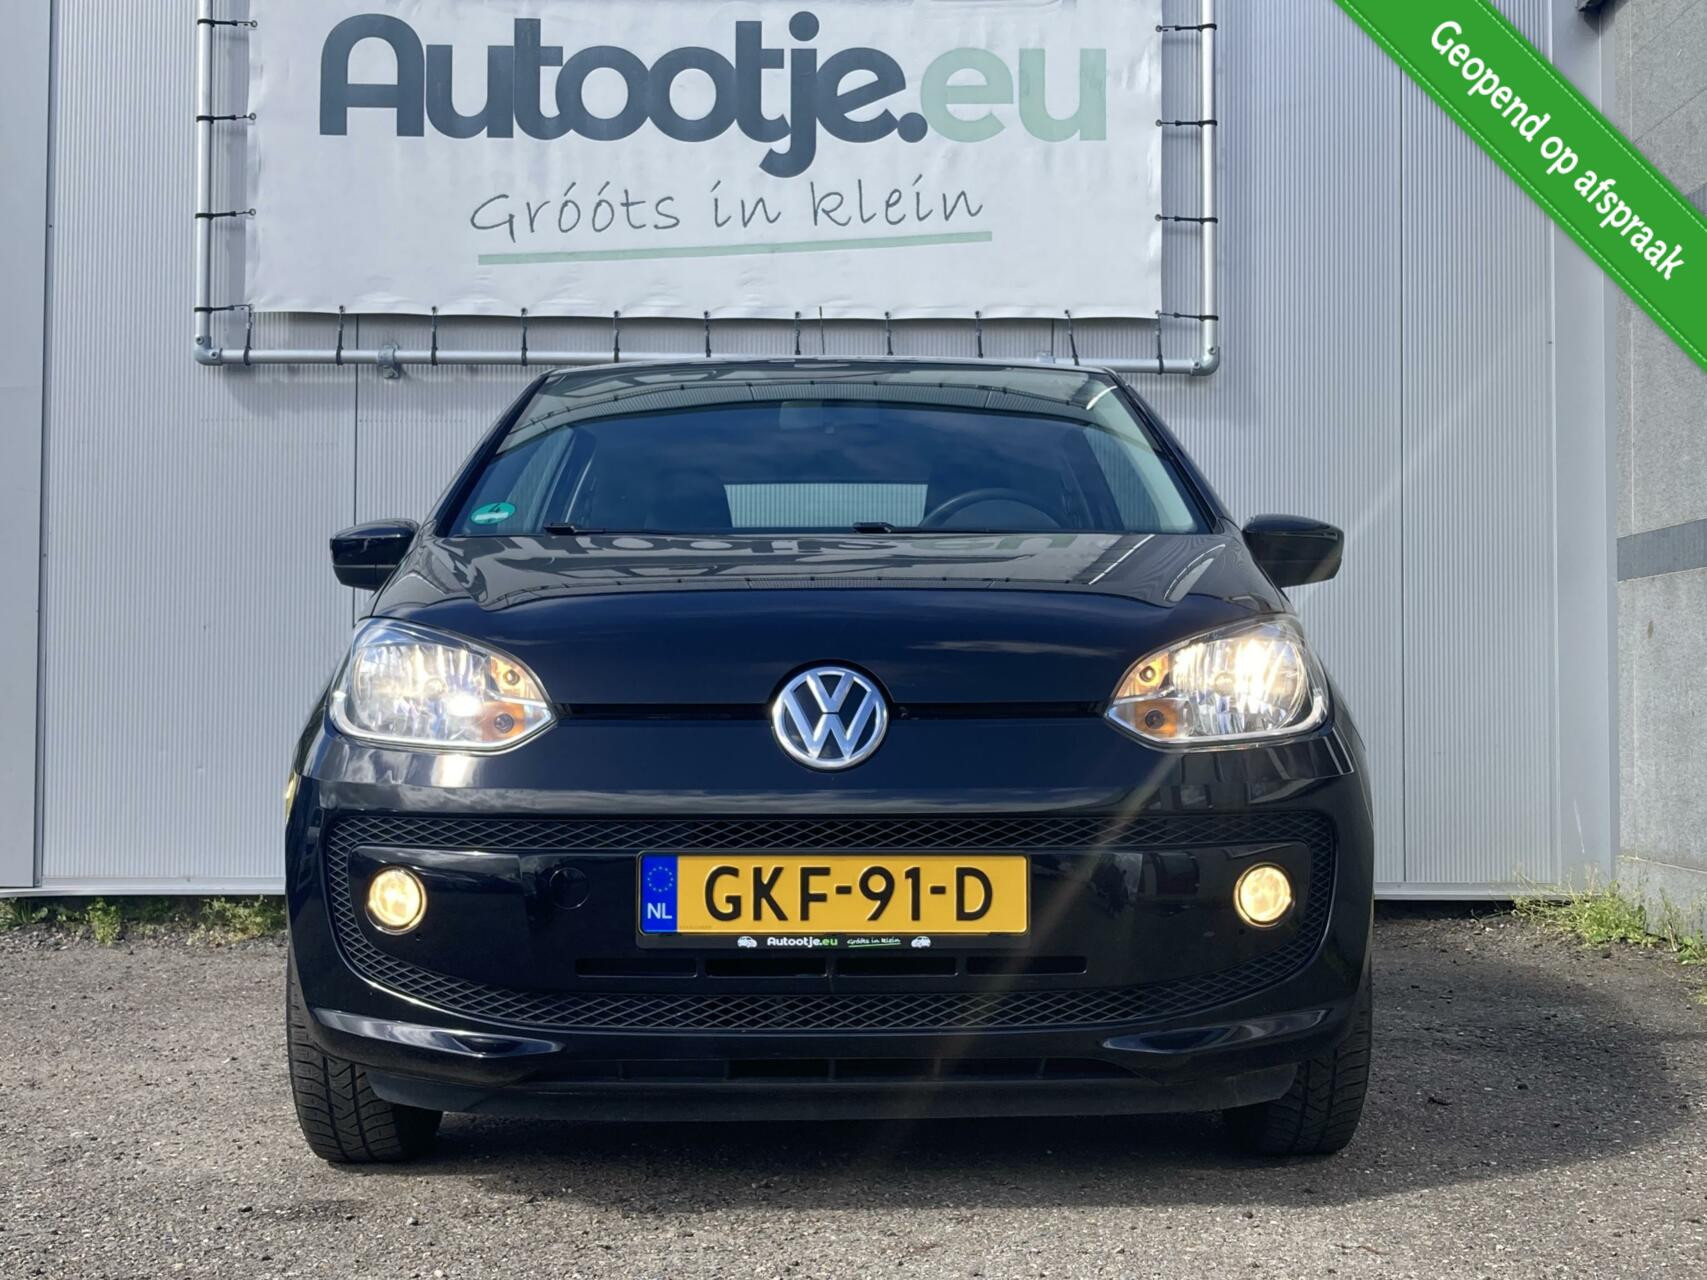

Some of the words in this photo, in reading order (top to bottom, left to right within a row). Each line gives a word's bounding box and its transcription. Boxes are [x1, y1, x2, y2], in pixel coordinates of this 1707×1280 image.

[319, 11, 1107, 178] Autootje.eu
[470, 182, 681, 241] Gróóts
[711, 181, 783, 228] in
[809, 174, 984, 226] klein
[647, 902, 672, 920] NL
[704, 866, 993, 921] GKF-91-D
[767, 936, 838, 948] Autootje.eu
